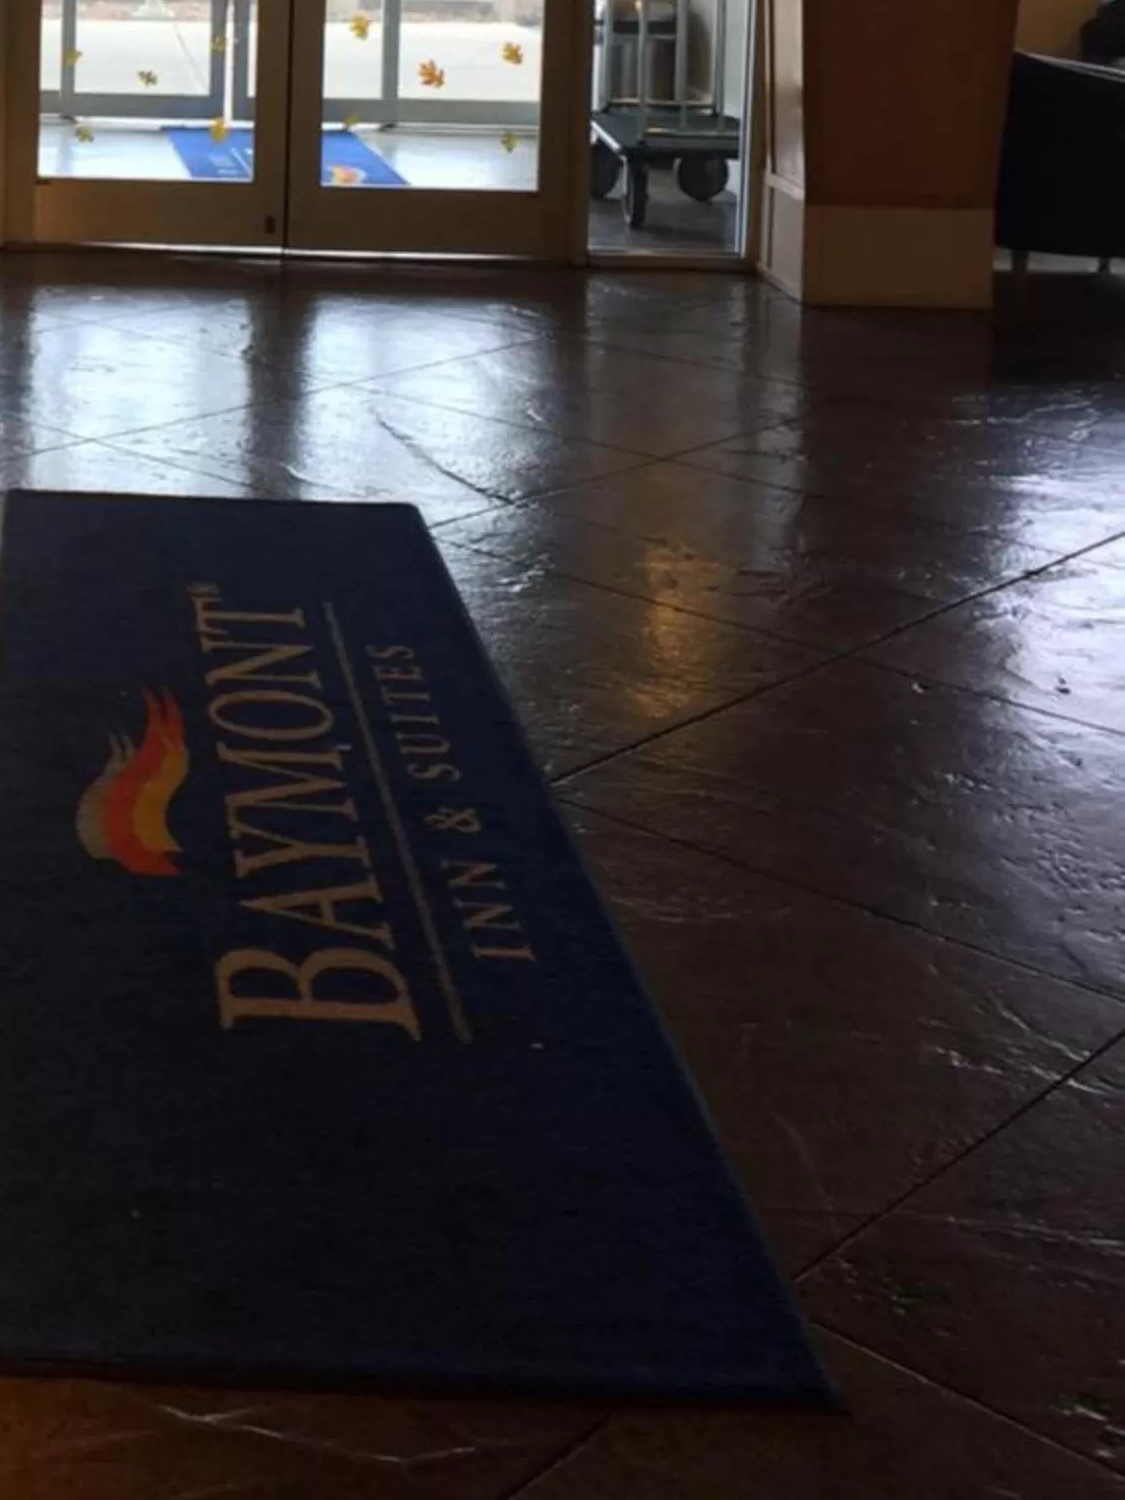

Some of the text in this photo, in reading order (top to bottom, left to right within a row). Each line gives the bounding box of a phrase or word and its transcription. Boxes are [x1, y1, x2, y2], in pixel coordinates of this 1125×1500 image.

[190, 593, 422, 1042] BAYMONT
[368, 644, 536, 963] INN & SUITES
